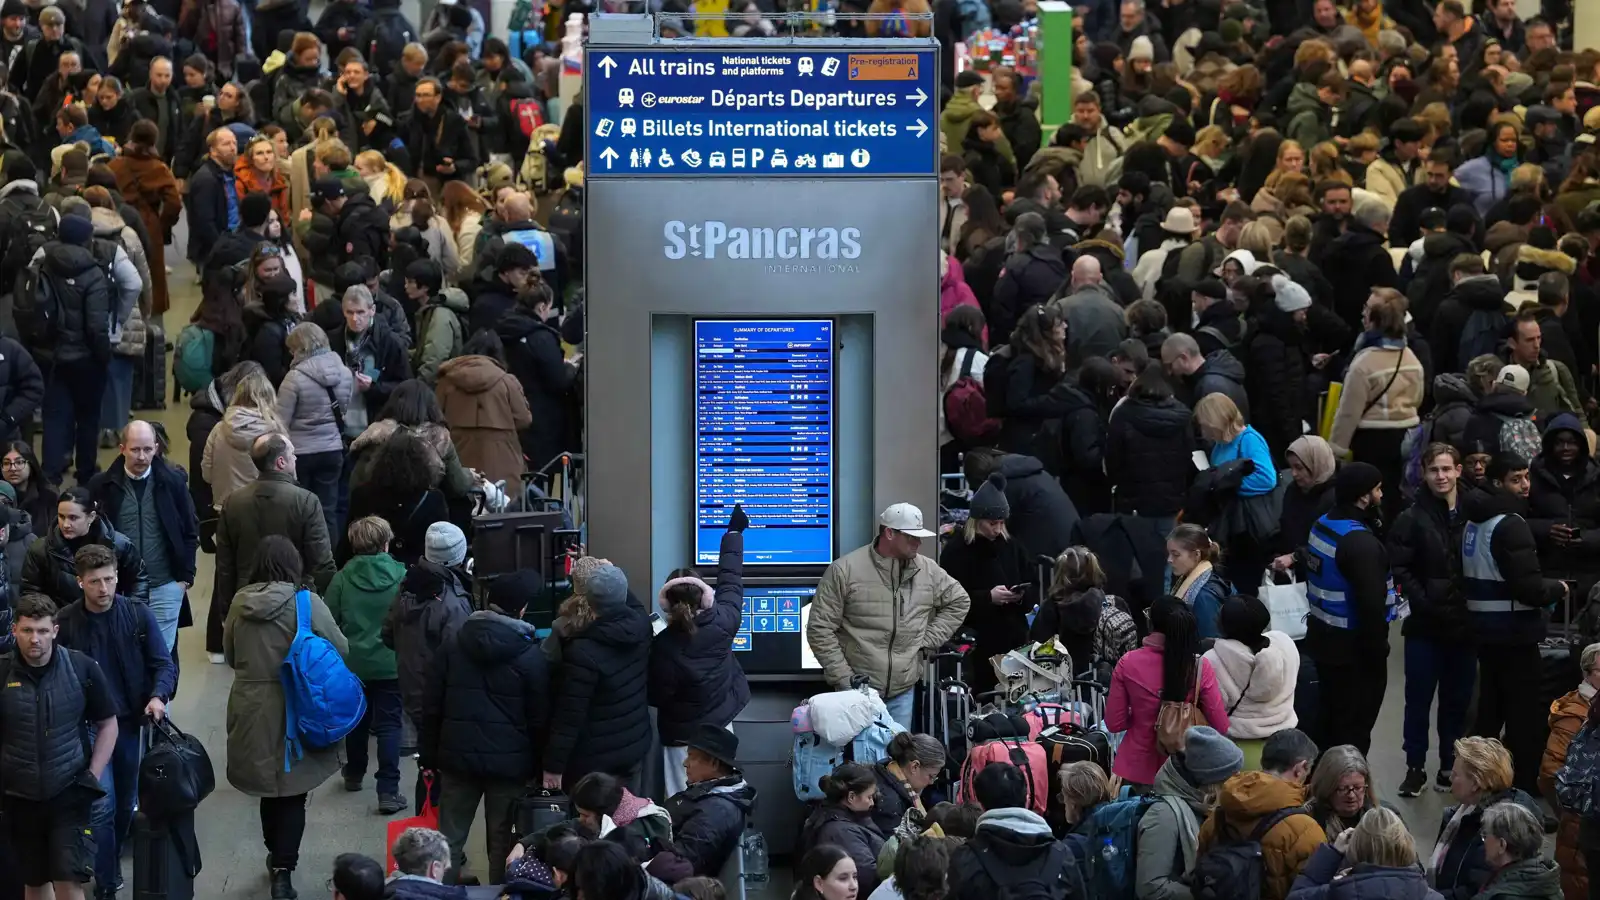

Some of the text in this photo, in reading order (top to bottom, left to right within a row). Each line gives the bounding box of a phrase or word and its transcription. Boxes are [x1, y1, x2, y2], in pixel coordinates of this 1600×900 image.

[722, 56, 791, 65] National tickets
[850, 57, 917, 67] Pre-registration
[629, 58, 715, 76] All trains
[722, 67, 784, 77] and platforms
[908, 67, 916, 77] A
[658, 89, 897, 111] eurostar Départs Departures
[643, 119, 897, 137] Billets International tickets
[751, 149, 764, 167] P
[764, 264, 861, 274] INTERNATIONAL
